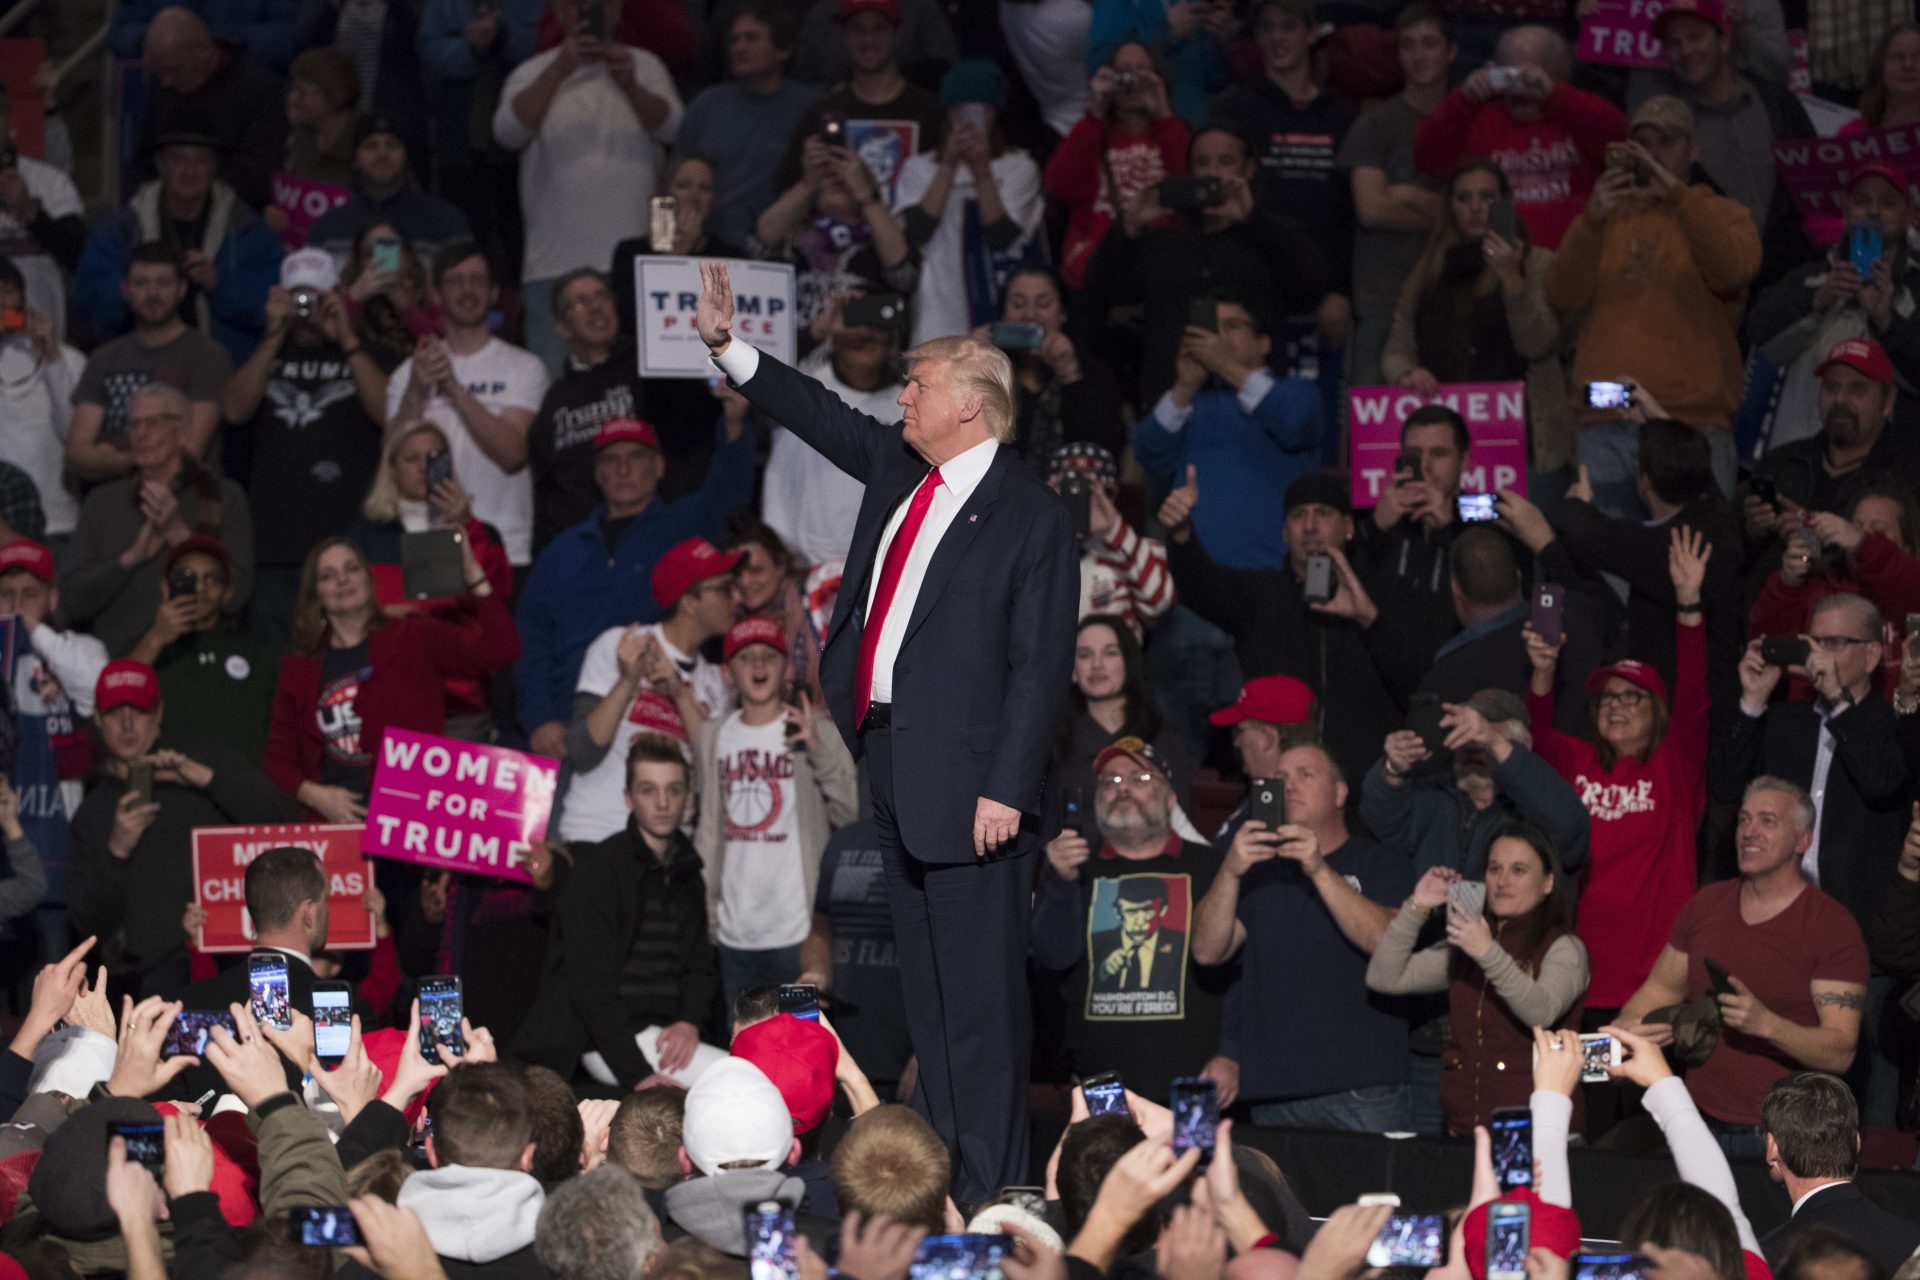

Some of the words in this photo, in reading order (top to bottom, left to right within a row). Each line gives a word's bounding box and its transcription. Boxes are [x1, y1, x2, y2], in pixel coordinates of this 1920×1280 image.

[1629, 0, 1665, 20] FO
[1589, 26, 1664, 58] TRU
[652, 292, 785, 316] TRMP
[664, 317, 774, 334] PECE
[1360, 465, 1518, 498] TMP
[384, 736, 557, 796] WOMEN
[425, 789, 489, 822] FOR
